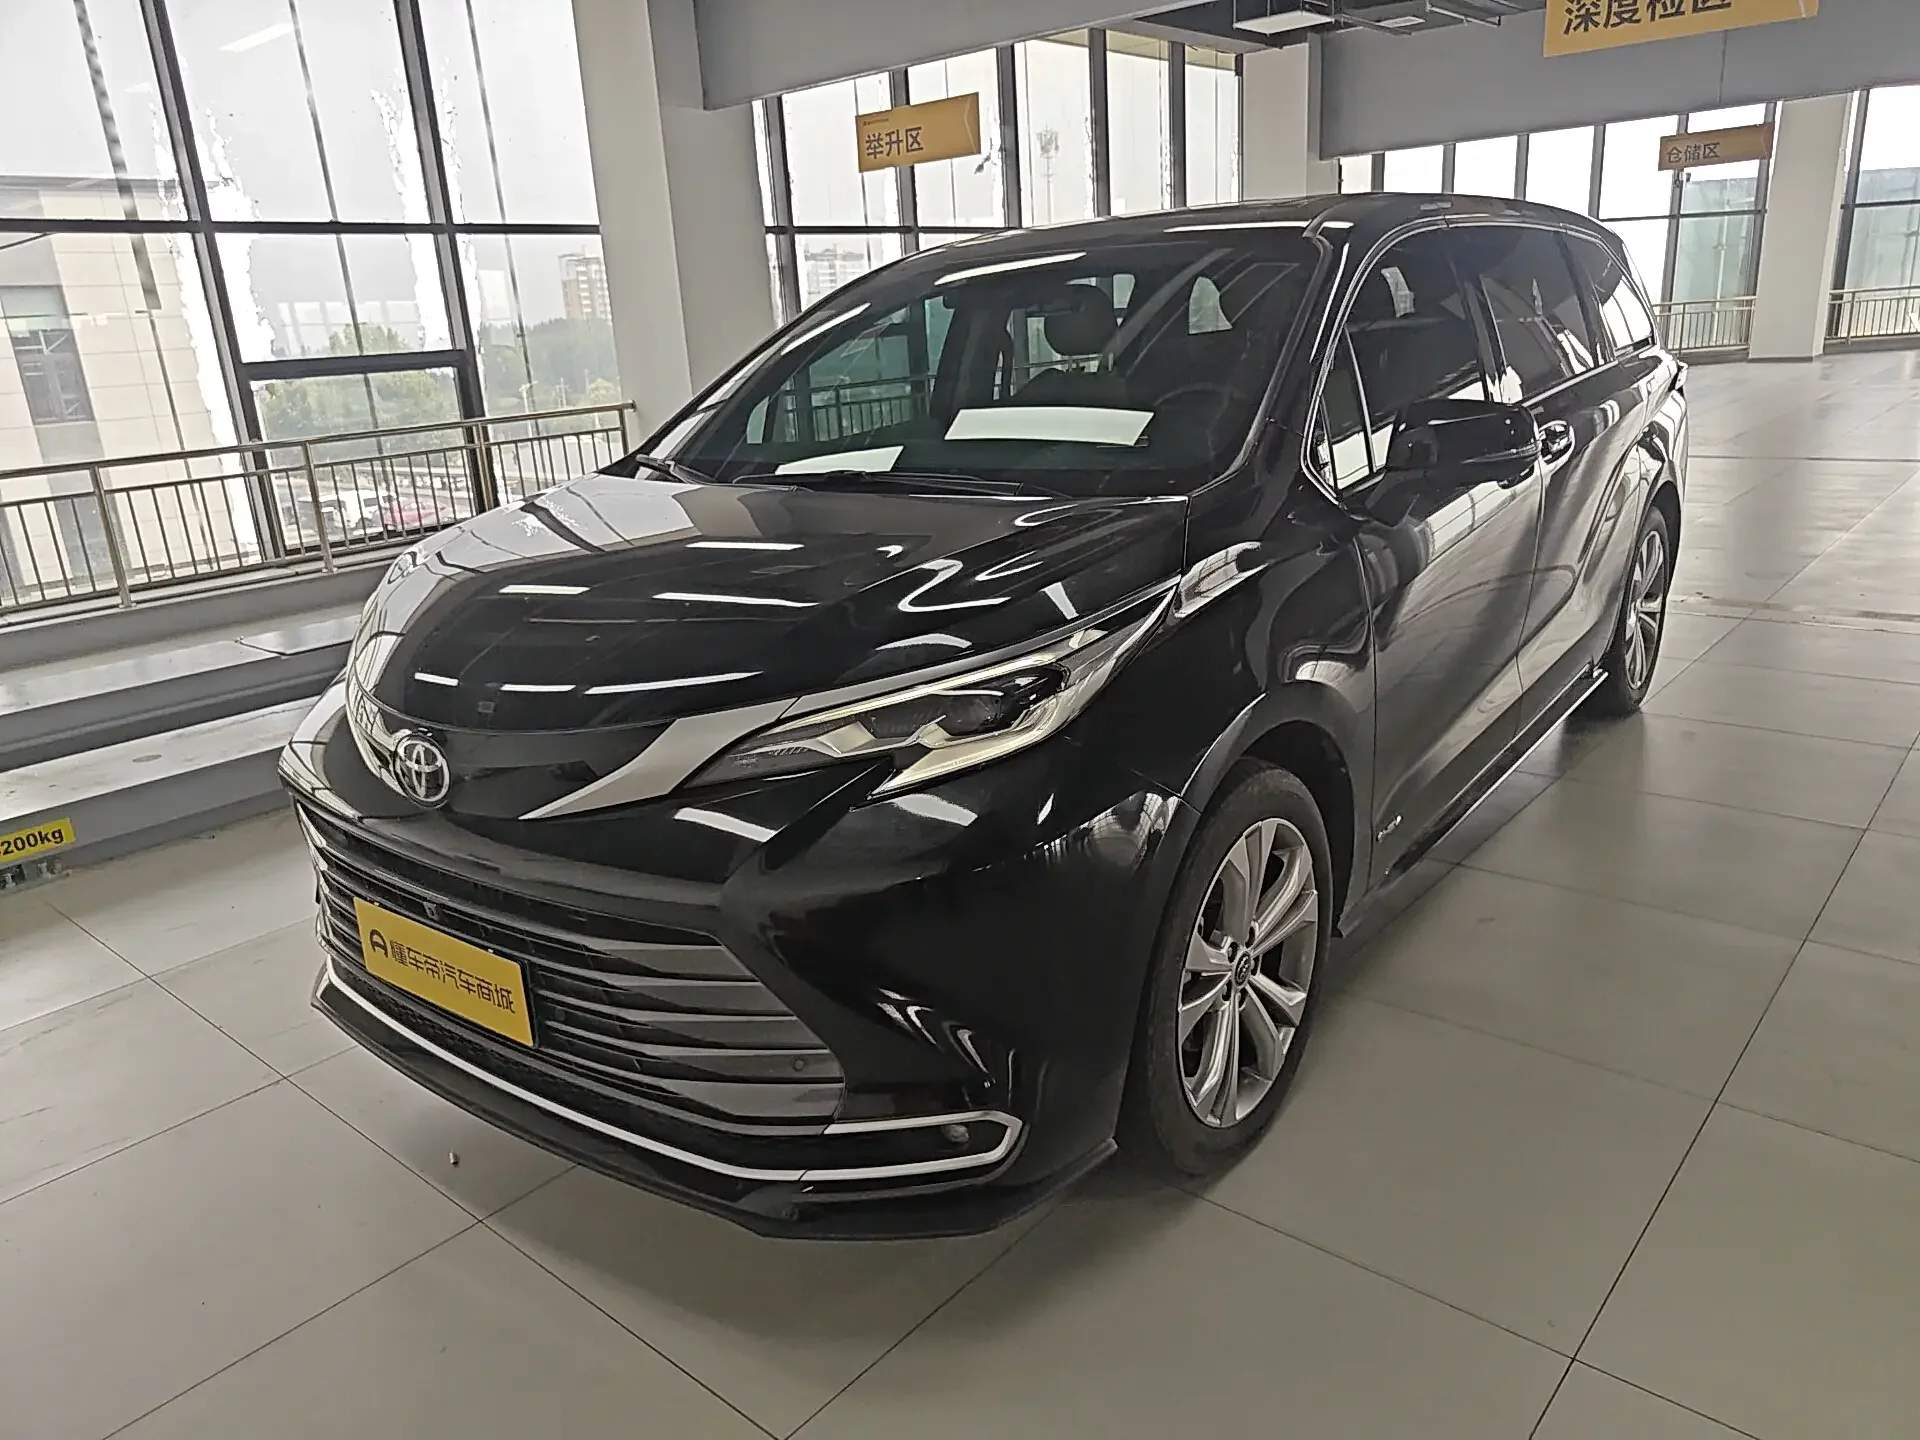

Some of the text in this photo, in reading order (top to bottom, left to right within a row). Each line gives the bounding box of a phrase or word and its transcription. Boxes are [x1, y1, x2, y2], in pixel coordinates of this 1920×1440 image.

[865, 126, 924, 159] 举升区
[1666, 142, 1720, 163] 仓储区
[0, 828, 64, 855] 200kg
[390, 939, 516, 1014] 懂车帝汽车商城
